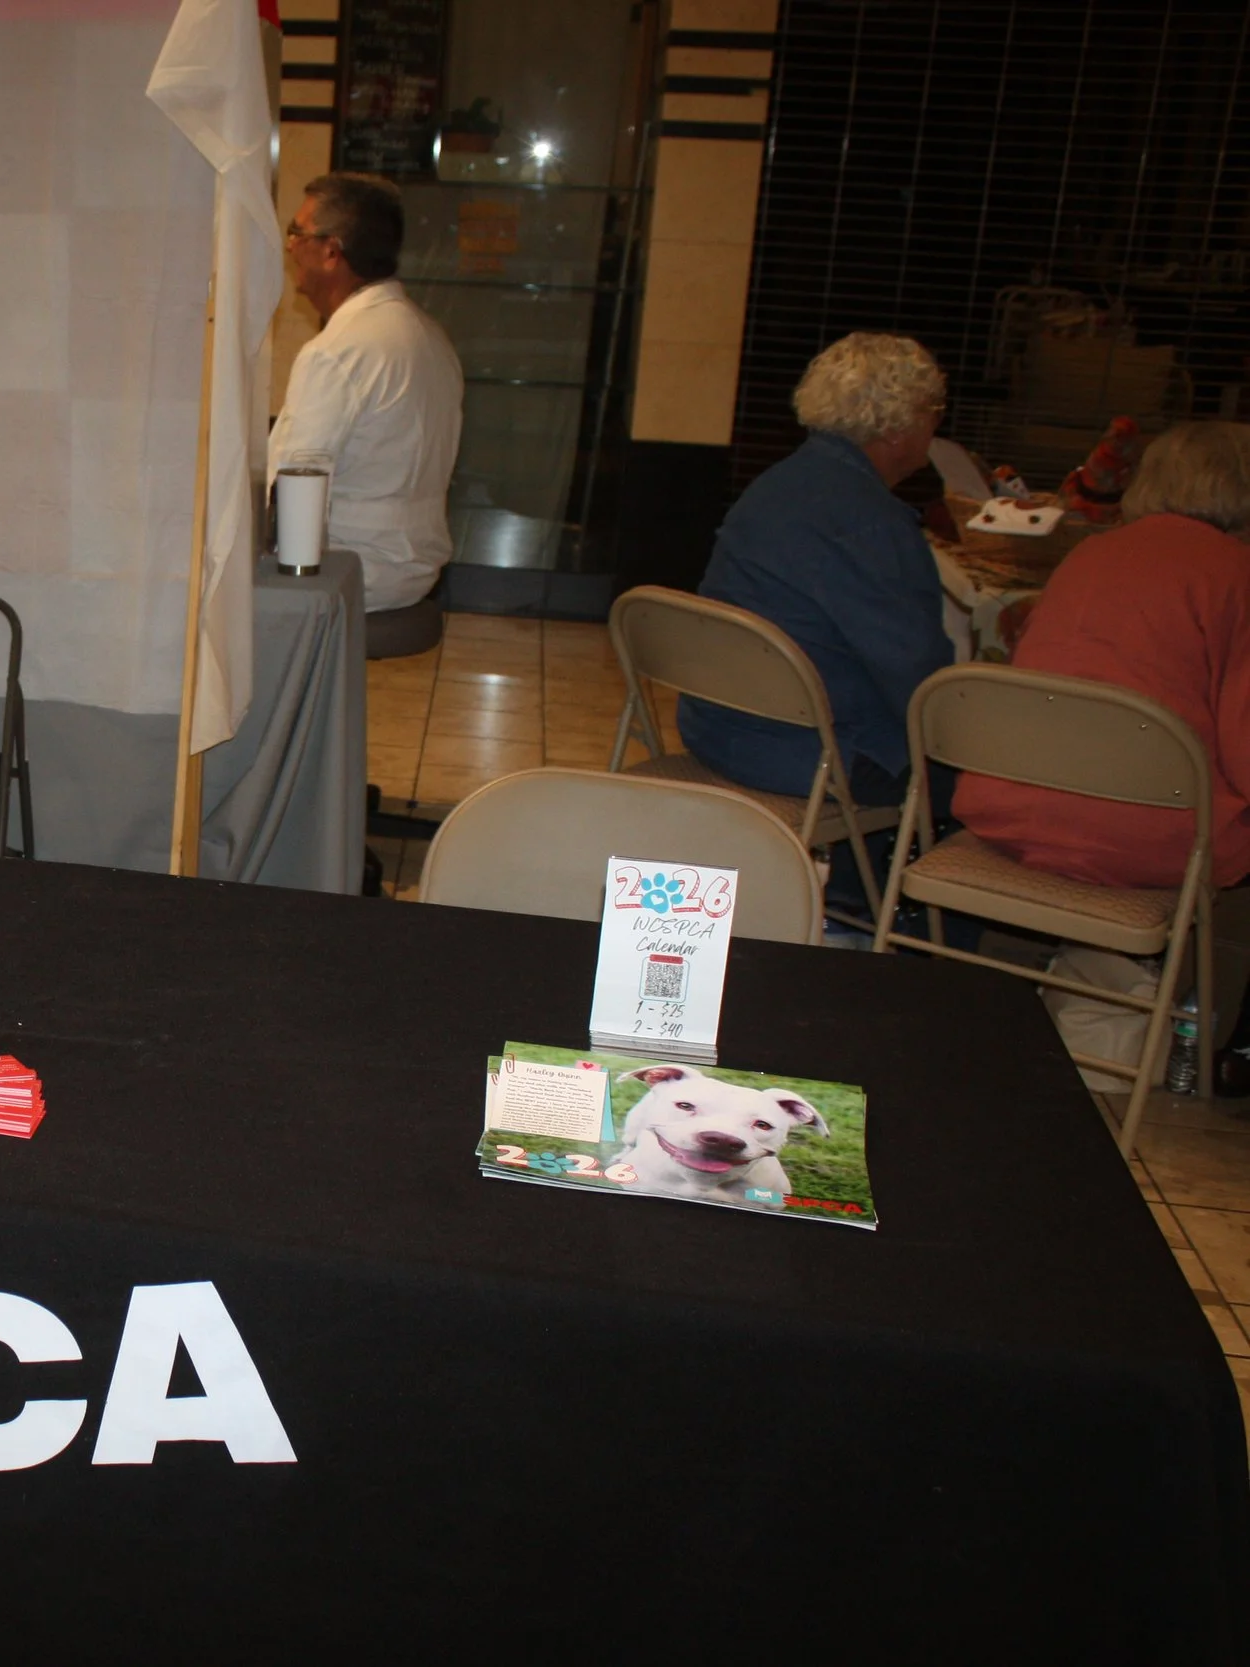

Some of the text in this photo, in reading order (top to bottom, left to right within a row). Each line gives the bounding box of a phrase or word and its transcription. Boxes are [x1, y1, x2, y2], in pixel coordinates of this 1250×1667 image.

[632, 916, 716, 939] WCSPCA
[635, 937, 701, 956] Calendar
[636, 1000, 645, 1015] 1
[661, 1001, 685, 1019] $25
[632, 1019, 643, 1034] 2
[659, 1021, 684, 1038] $40
[783, 1196, 863, 1214] SPCA
